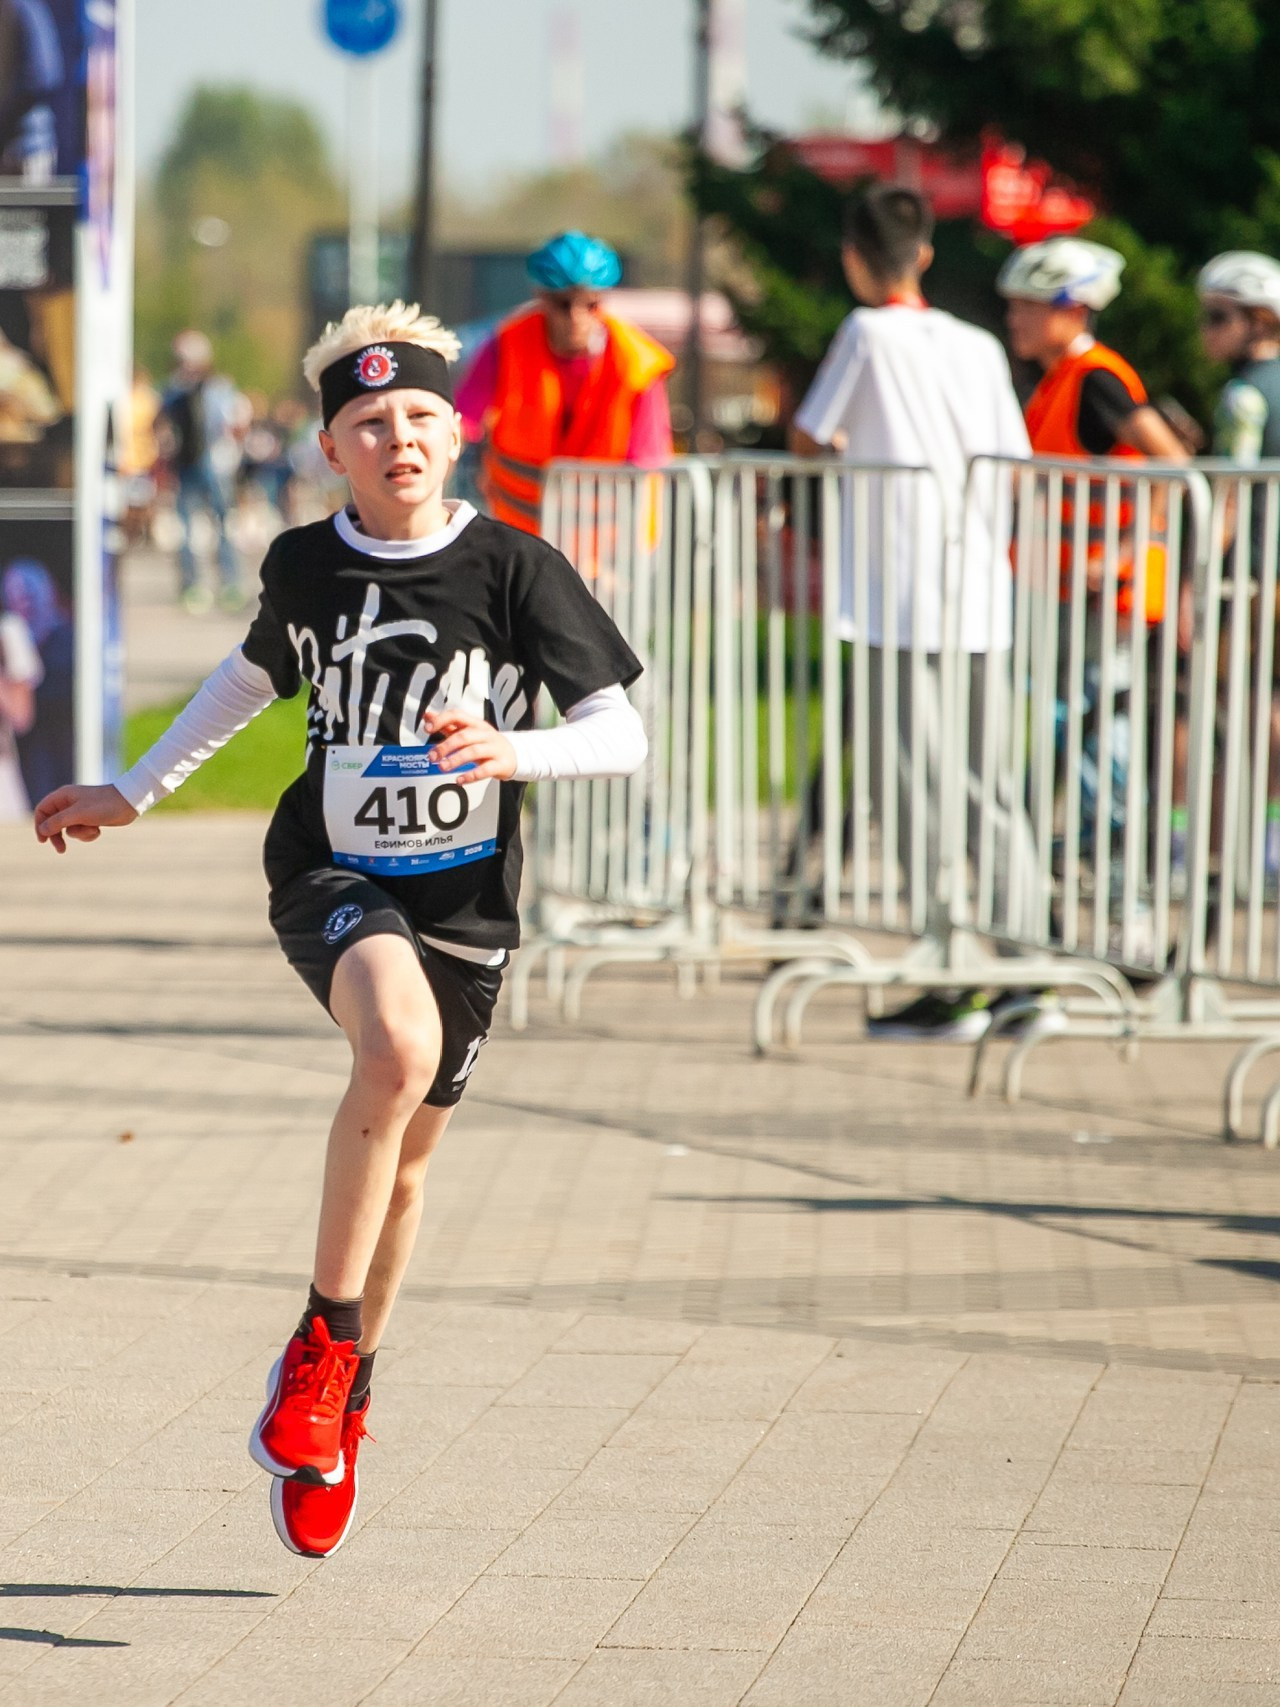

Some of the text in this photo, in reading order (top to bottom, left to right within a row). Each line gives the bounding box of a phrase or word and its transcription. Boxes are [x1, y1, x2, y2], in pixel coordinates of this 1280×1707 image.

[353, 782, 470, 836] 410
[374, 834, 454, 850] ЕФИМОВ ИЛЬЯ
